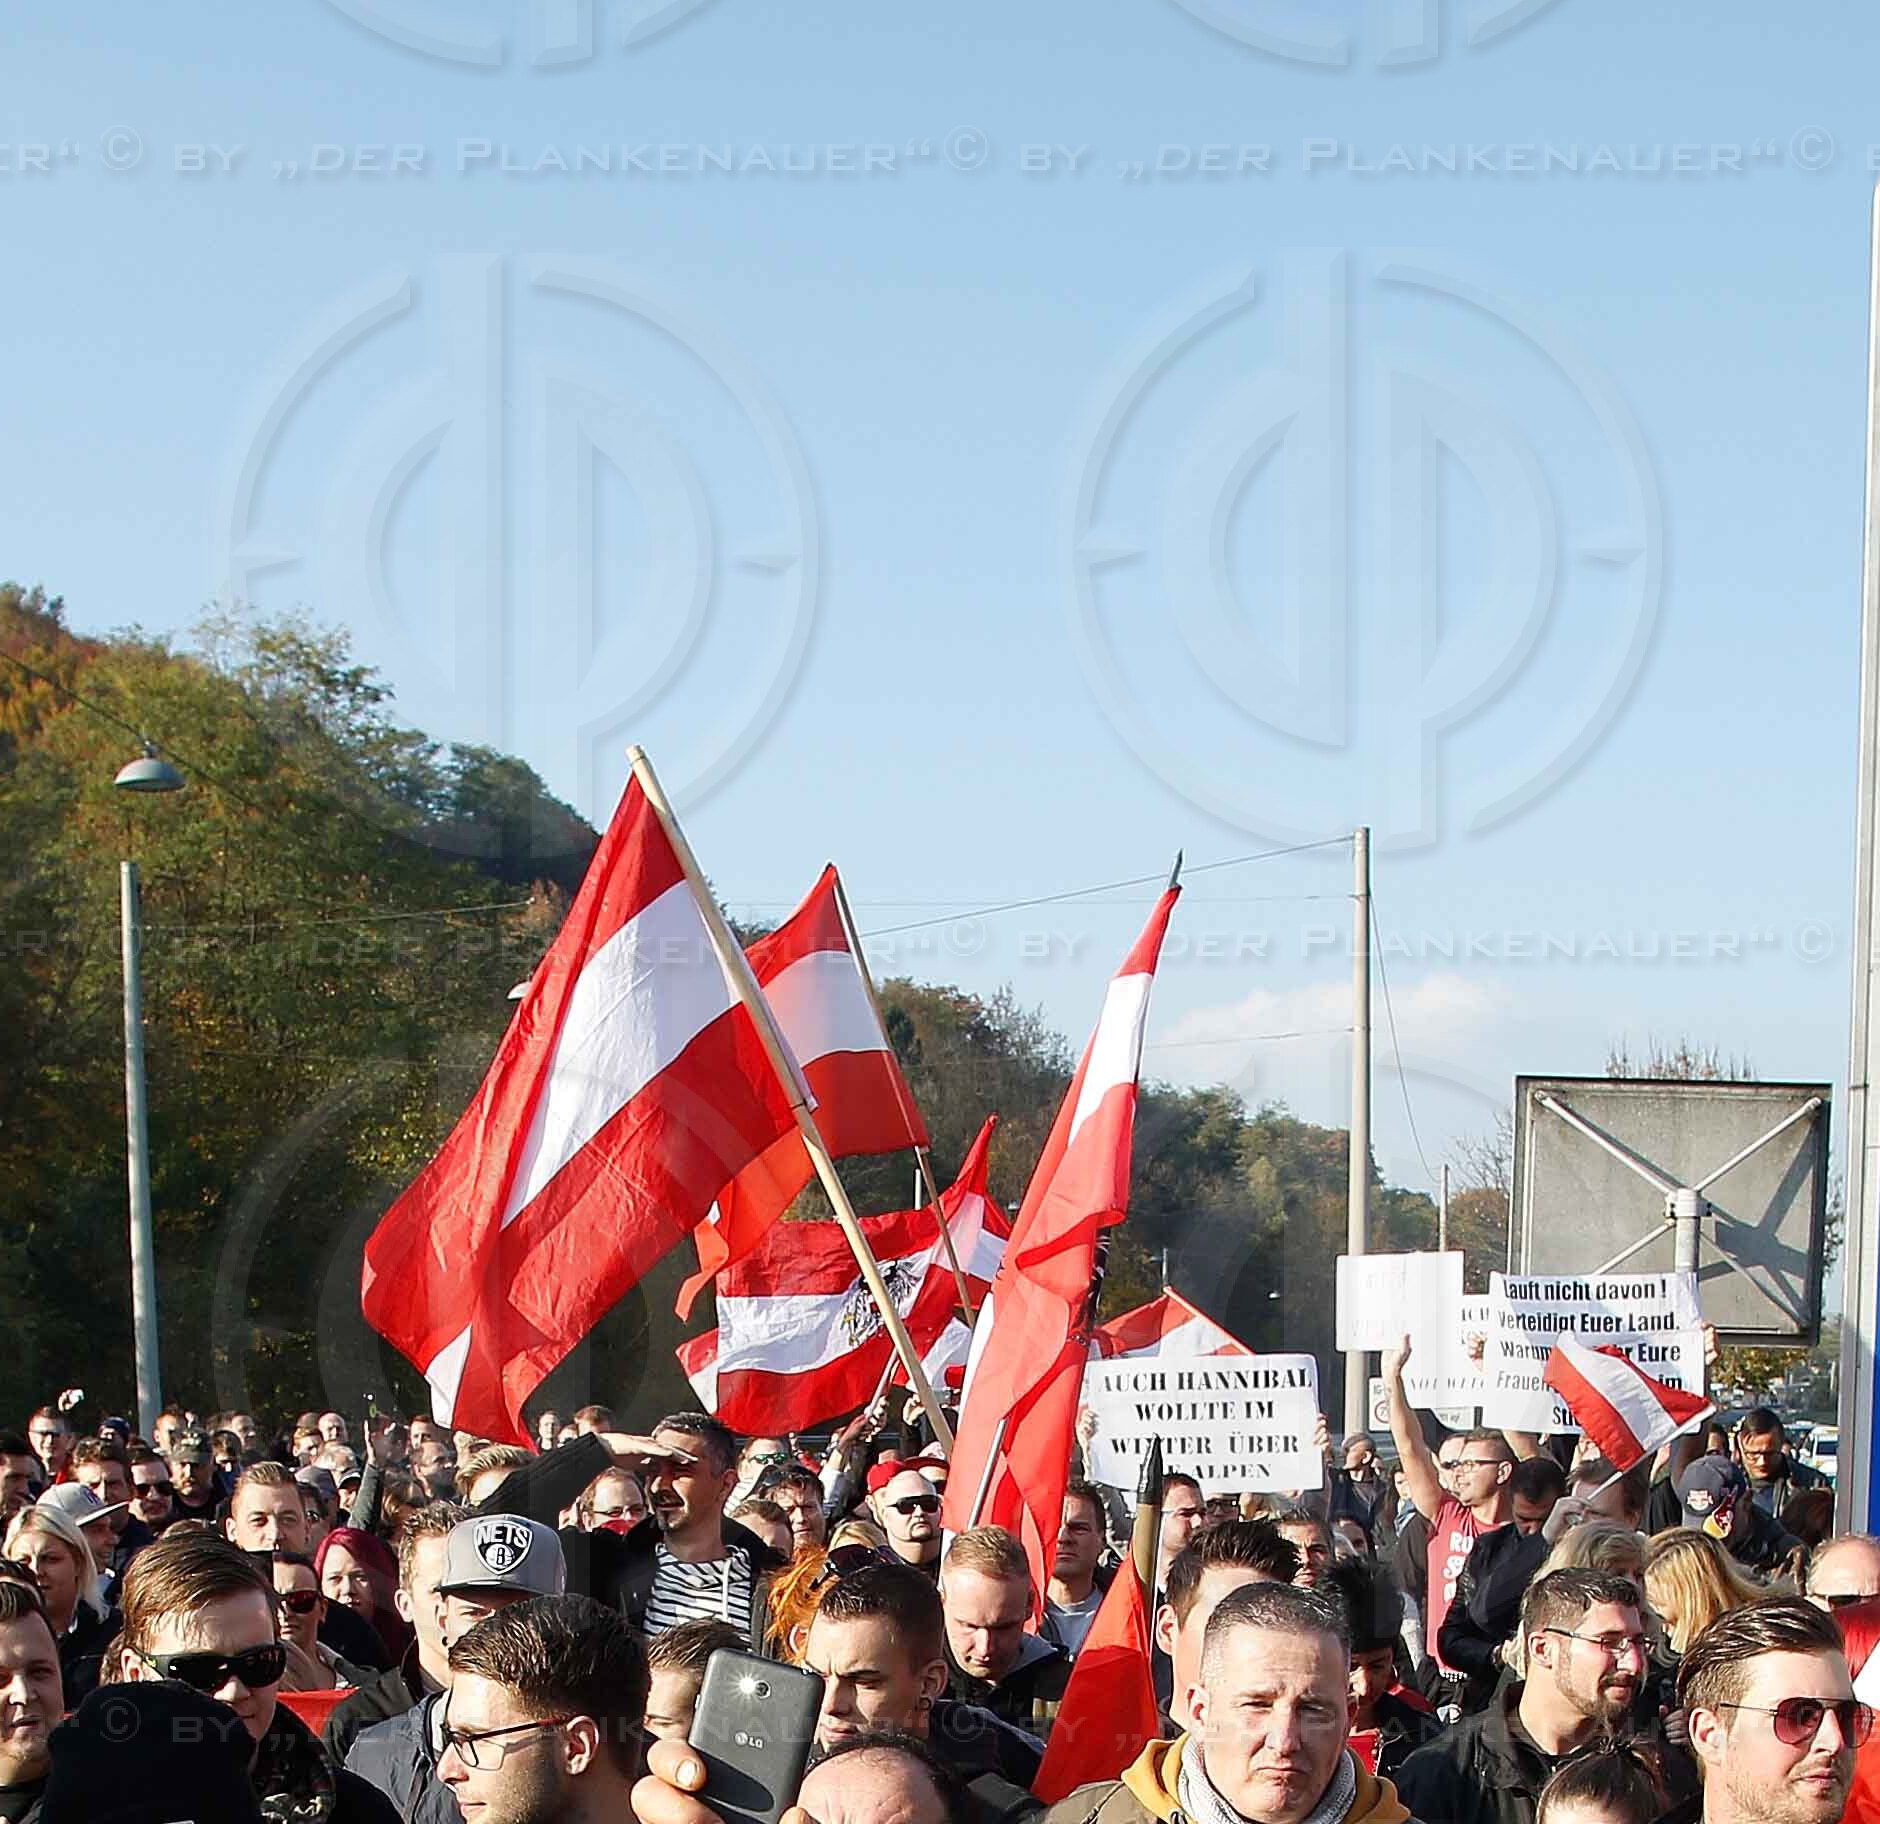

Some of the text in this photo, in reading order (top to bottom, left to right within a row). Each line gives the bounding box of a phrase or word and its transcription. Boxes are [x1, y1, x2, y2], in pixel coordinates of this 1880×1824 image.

[1544, 1279, 1590, 1301] nicht
[1595, 1282, 1656, 1300] davon
[1580, 1313, 1623, 1333] Euer
[1628, 1312, 1681, 1331] Land.
[1638, 1343, 1681, 1362] Eure
[1103, 1367, 1312, 1392] AUCH HANNIBAL
[1134, 1400, 1274, 1422] WOLLTE IM
[1229, 1431, 1299, 1454] ÜBER
[1192, 1463, 1272, 1480] ALPEN
[477, 1523, 528, 1548] NETS
